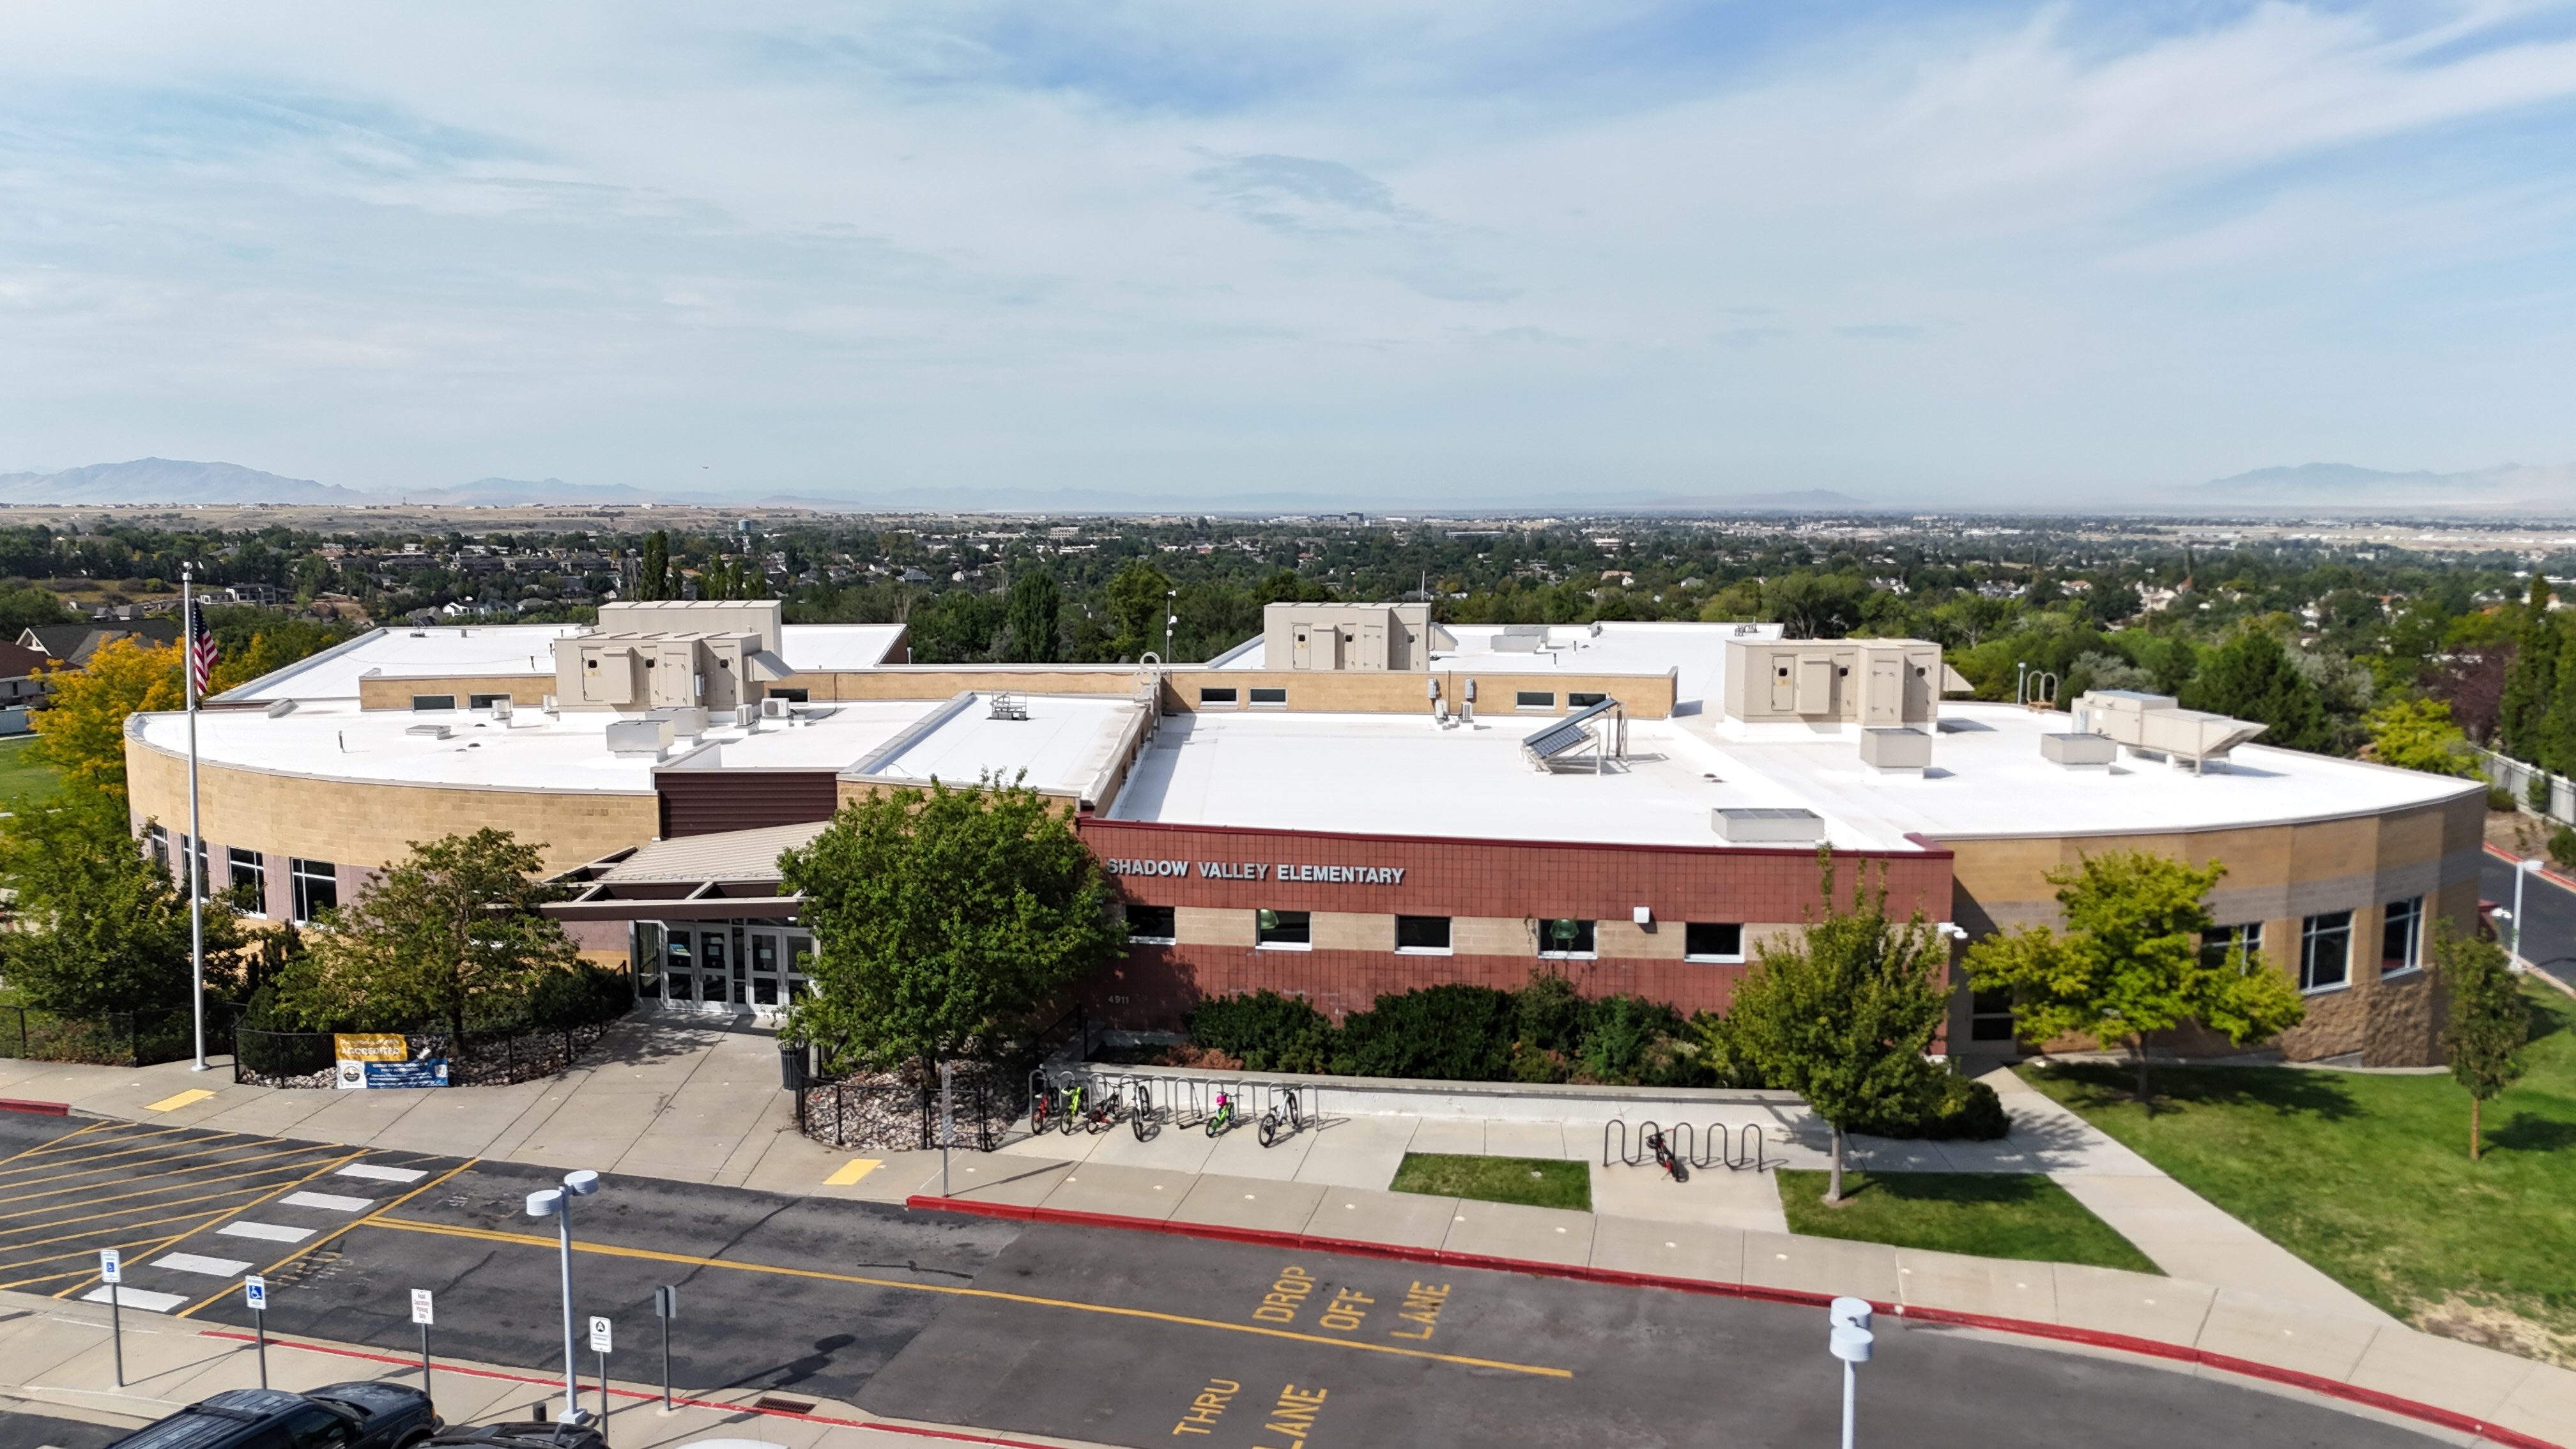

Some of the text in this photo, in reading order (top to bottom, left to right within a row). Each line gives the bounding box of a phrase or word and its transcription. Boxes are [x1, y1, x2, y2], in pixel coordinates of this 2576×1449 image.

[1107, 858, 1404, 883] SHADOW VALLEY ELEMENTARY
[1108, 995, 1129, 1004] 4911
[341, 1047, 400, 1056] ACCREDITED
[1252, 1266, 1316, 1322] DROP
[1319, 1289, 1374, 1330] OFF
[1390, 1280, 1451, 1339] LANE
[1172, 1378, 1239, 1435] THRU
